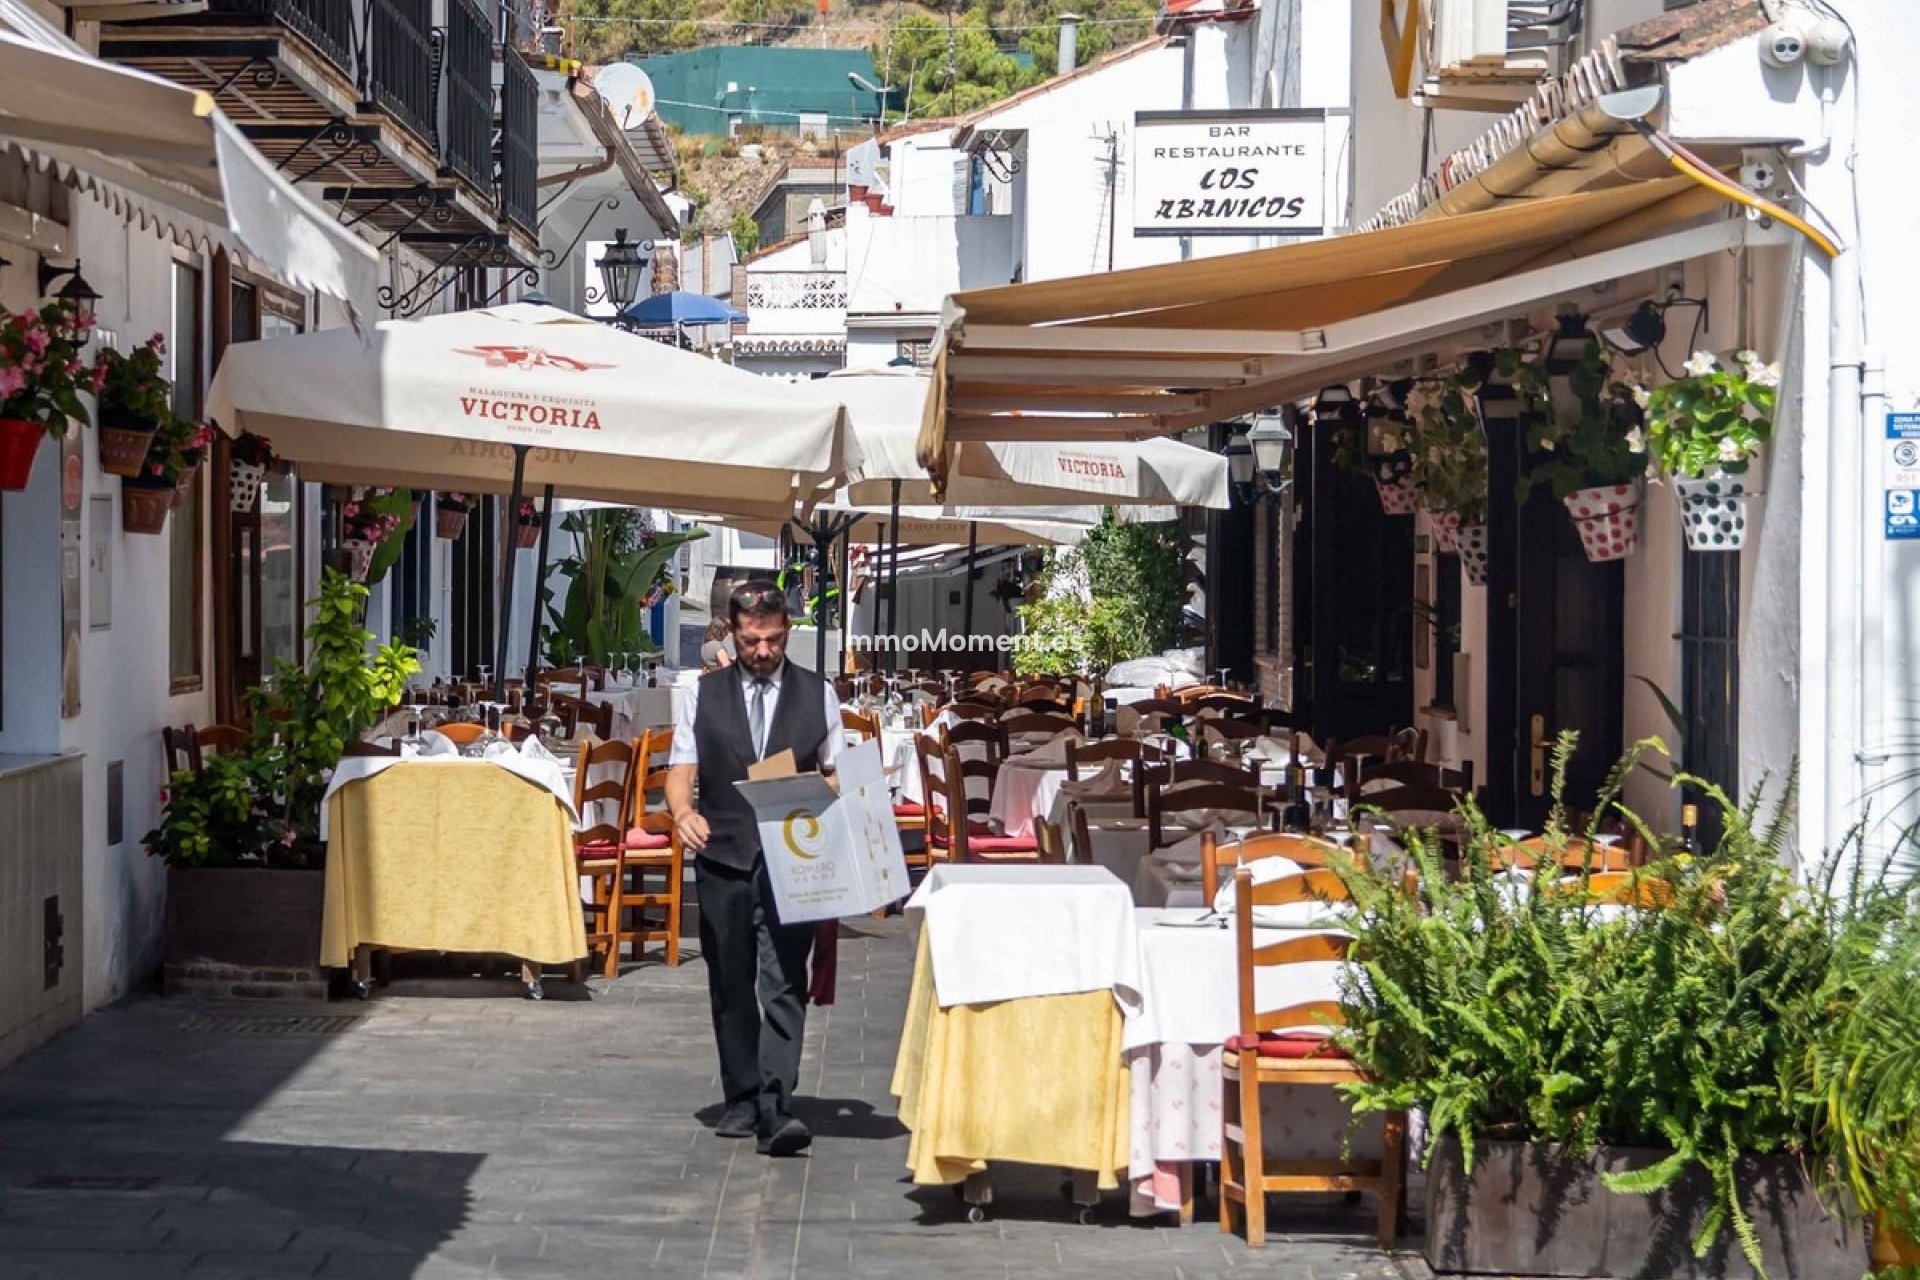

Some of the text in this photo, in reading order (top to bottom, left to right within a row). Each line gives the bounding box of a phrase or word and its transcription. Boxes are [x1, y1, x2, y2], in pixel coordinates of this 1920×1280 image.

[1209, 126, 1251, 137] BAR
[1154, 144, 1306, 159] RESTAURANTE
[1200, 167, 1259, 190] LOS
[1155, 196, 1305, 219] ABANICOS
[460, 397, 601, 430] VICTORIA
[1057, 458, 1126, 478] VICTORIA
